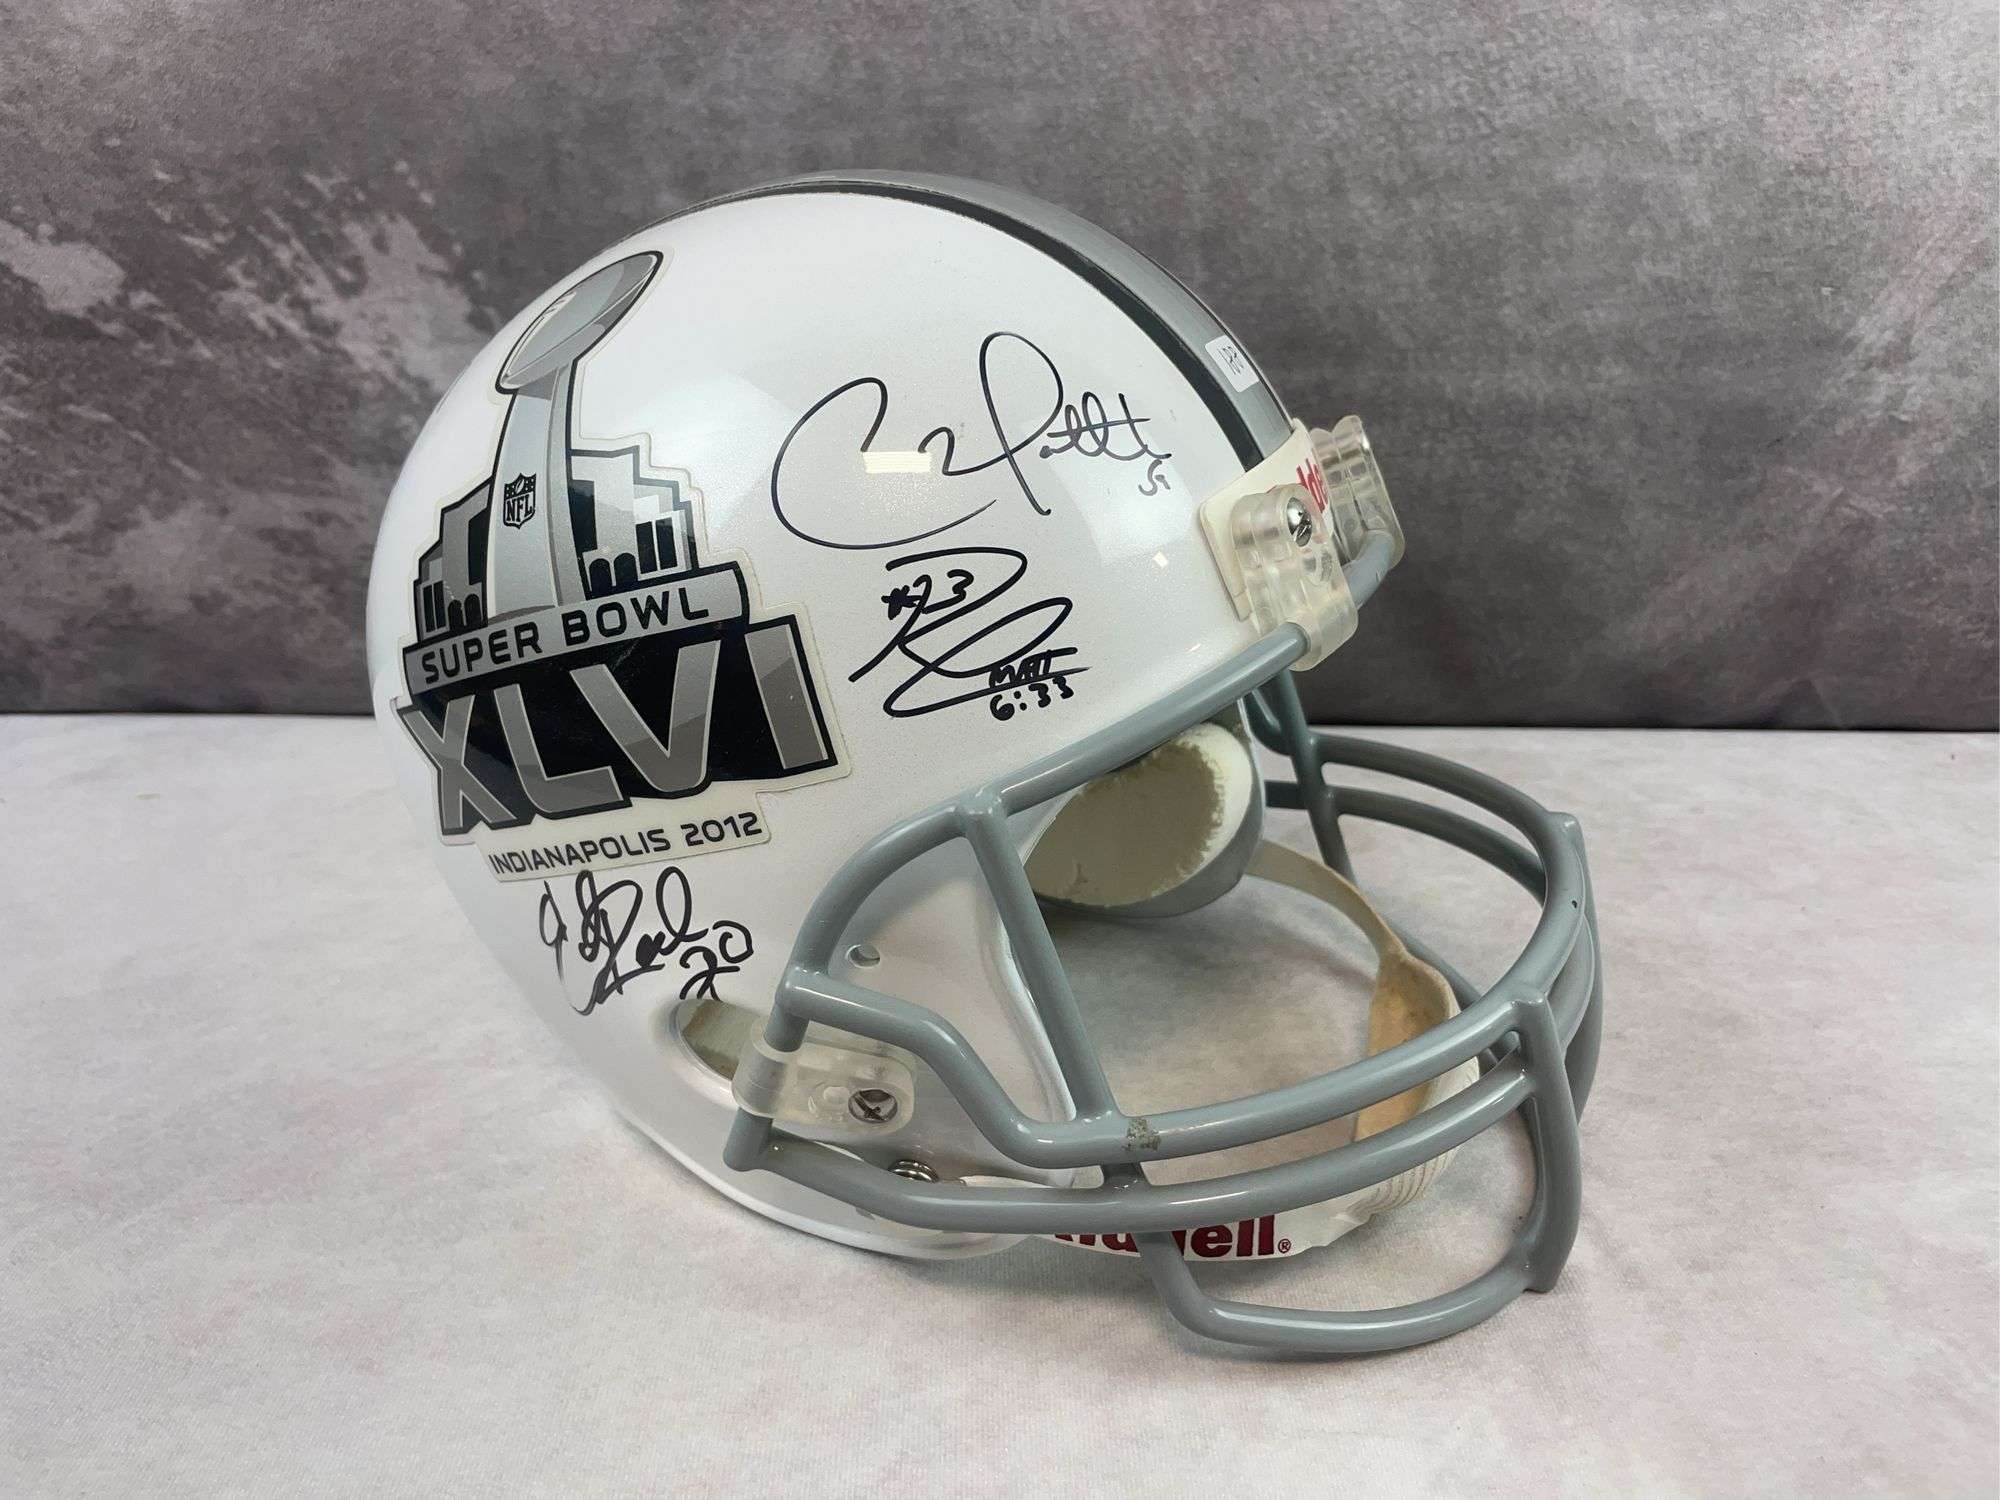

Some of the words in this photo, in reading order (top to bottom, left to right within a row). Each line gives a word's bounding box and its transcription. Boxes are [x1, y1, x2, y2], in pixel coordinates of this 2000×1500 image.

[505, 493, 534, 522] NFL
[421, 621, 541, 684] SUPER
[561, 586, 710, 647] BOWL
[400, 624, 829, 831] XLVI
[989, 676, 1074, 721] 6:33
[487, 828, 672, 875] INDIANAPOLIS
[680, 811, 763, 847] 2012
